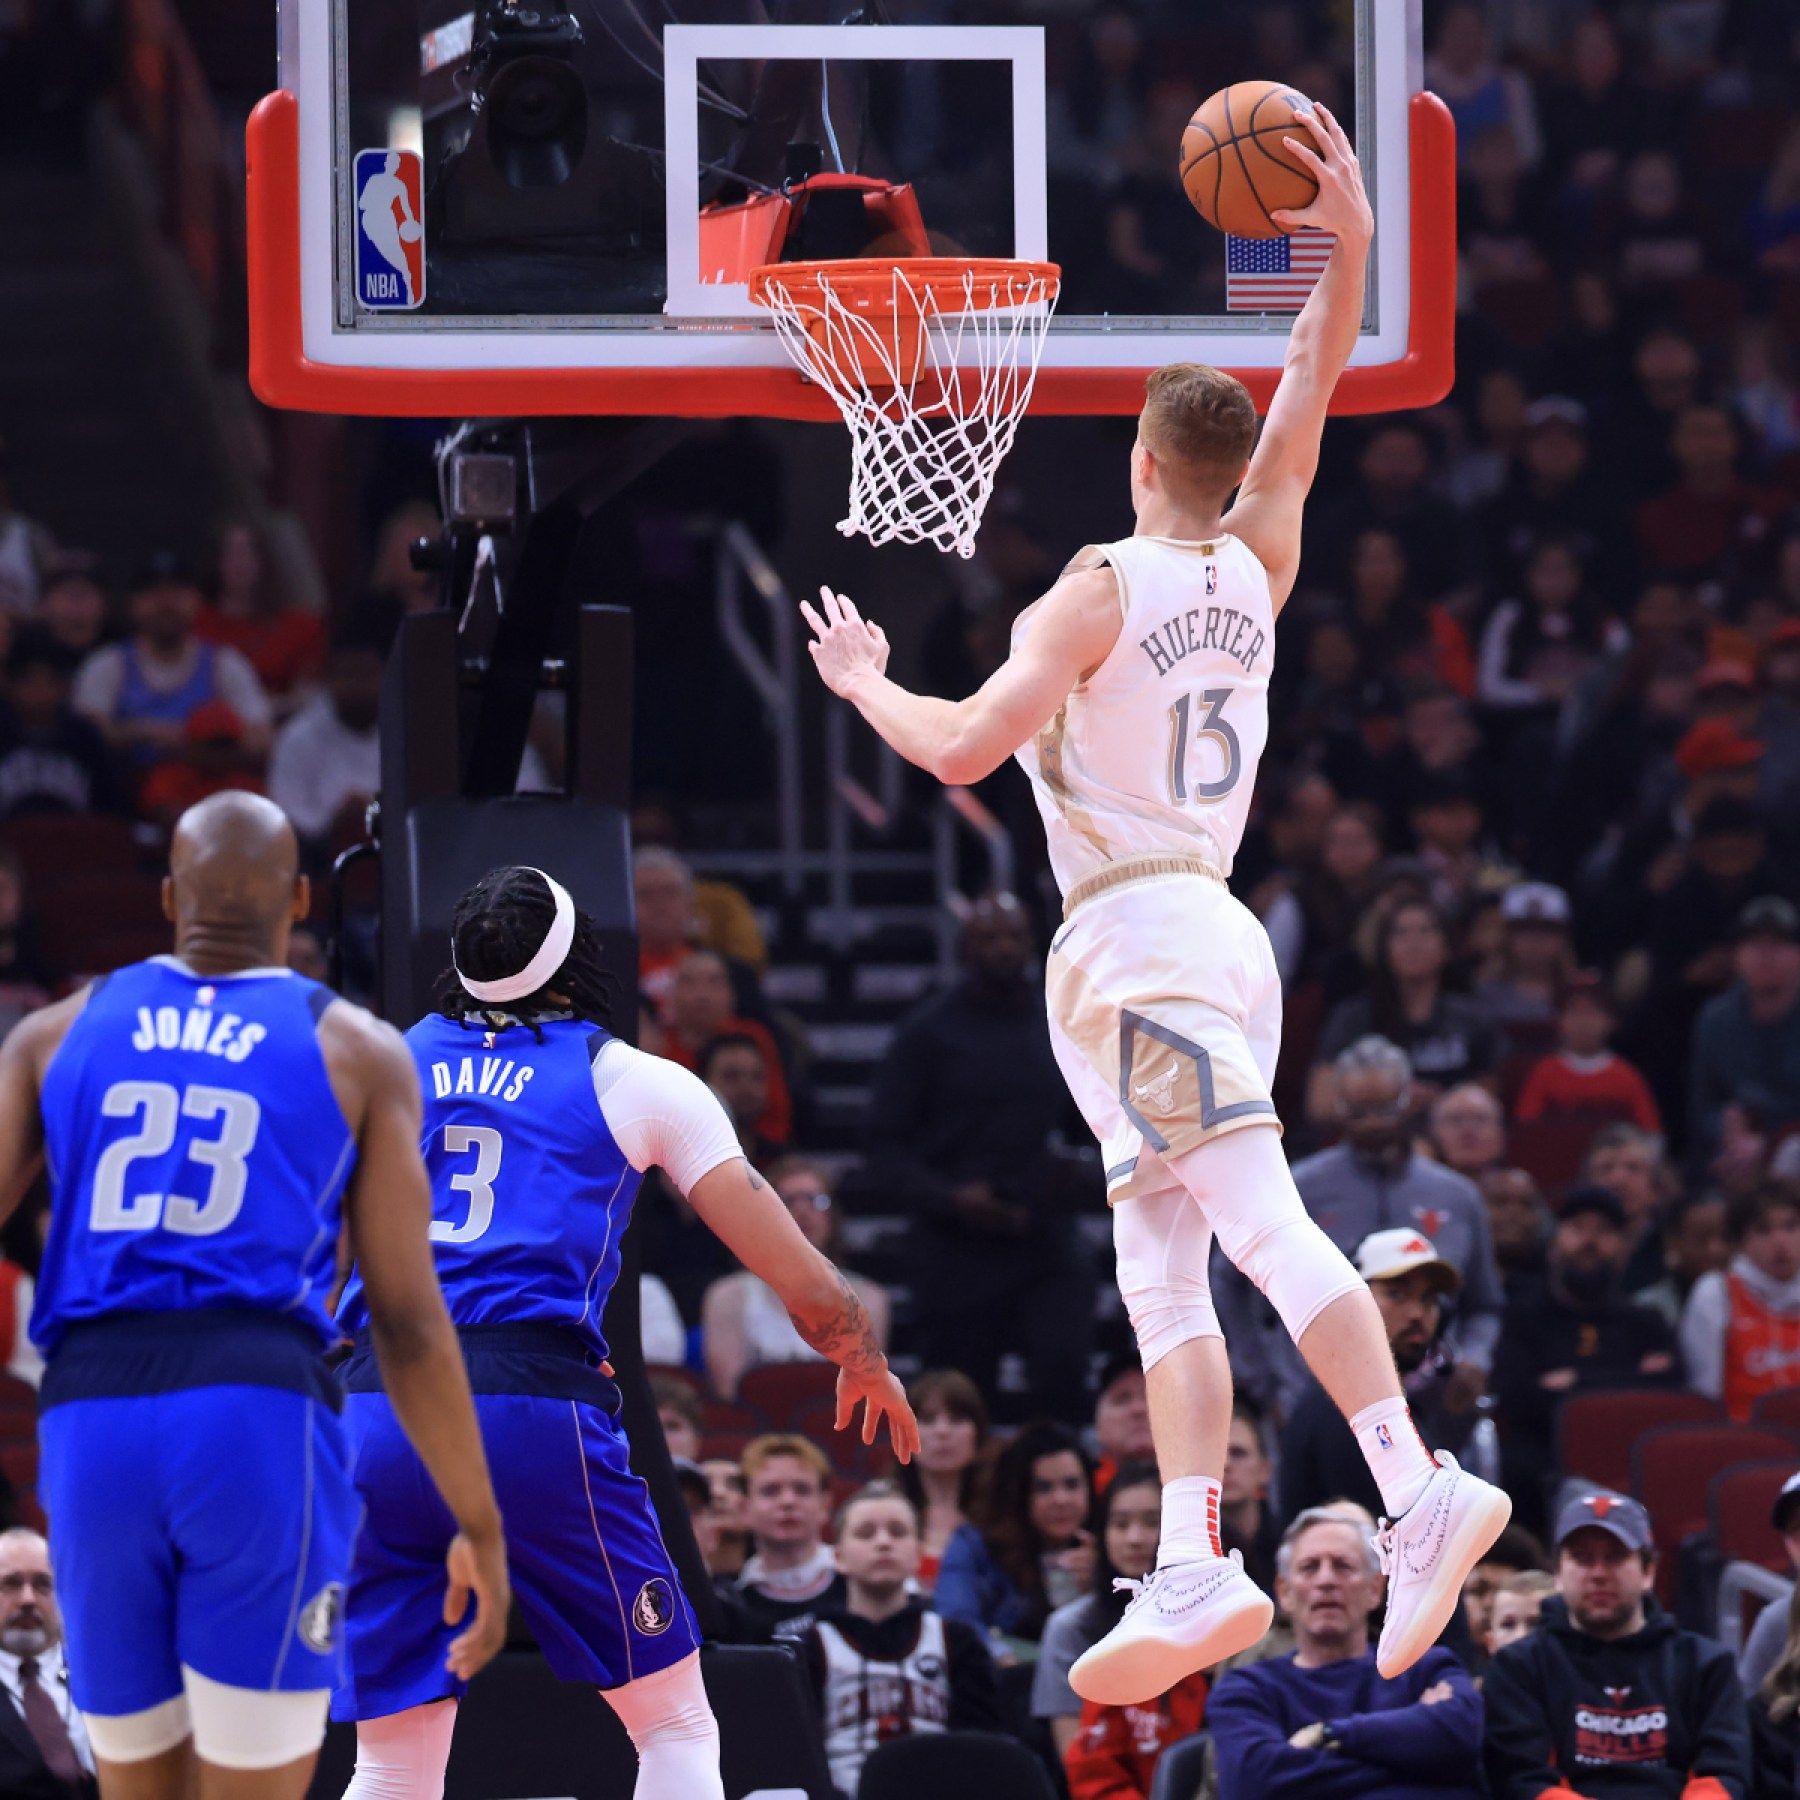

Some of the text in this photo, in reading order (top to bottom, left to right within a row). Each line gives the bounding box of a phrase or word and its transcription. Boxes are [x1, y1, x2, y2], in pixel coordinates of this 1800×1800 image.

[366, 273, 399, 298] NBA
[1139, 607, 1265, 677] HUERTER
[1167, 688, 1241, 807] 13
[132, 1006, 267, 1063] JONES
[431, 1056, 534, 1102] DAVIS
[90, 1079, 261, 1237] 23
[428, 1124, 503, 1243] 3
[1575, 1710, 1667, 1734] CHICAGO
